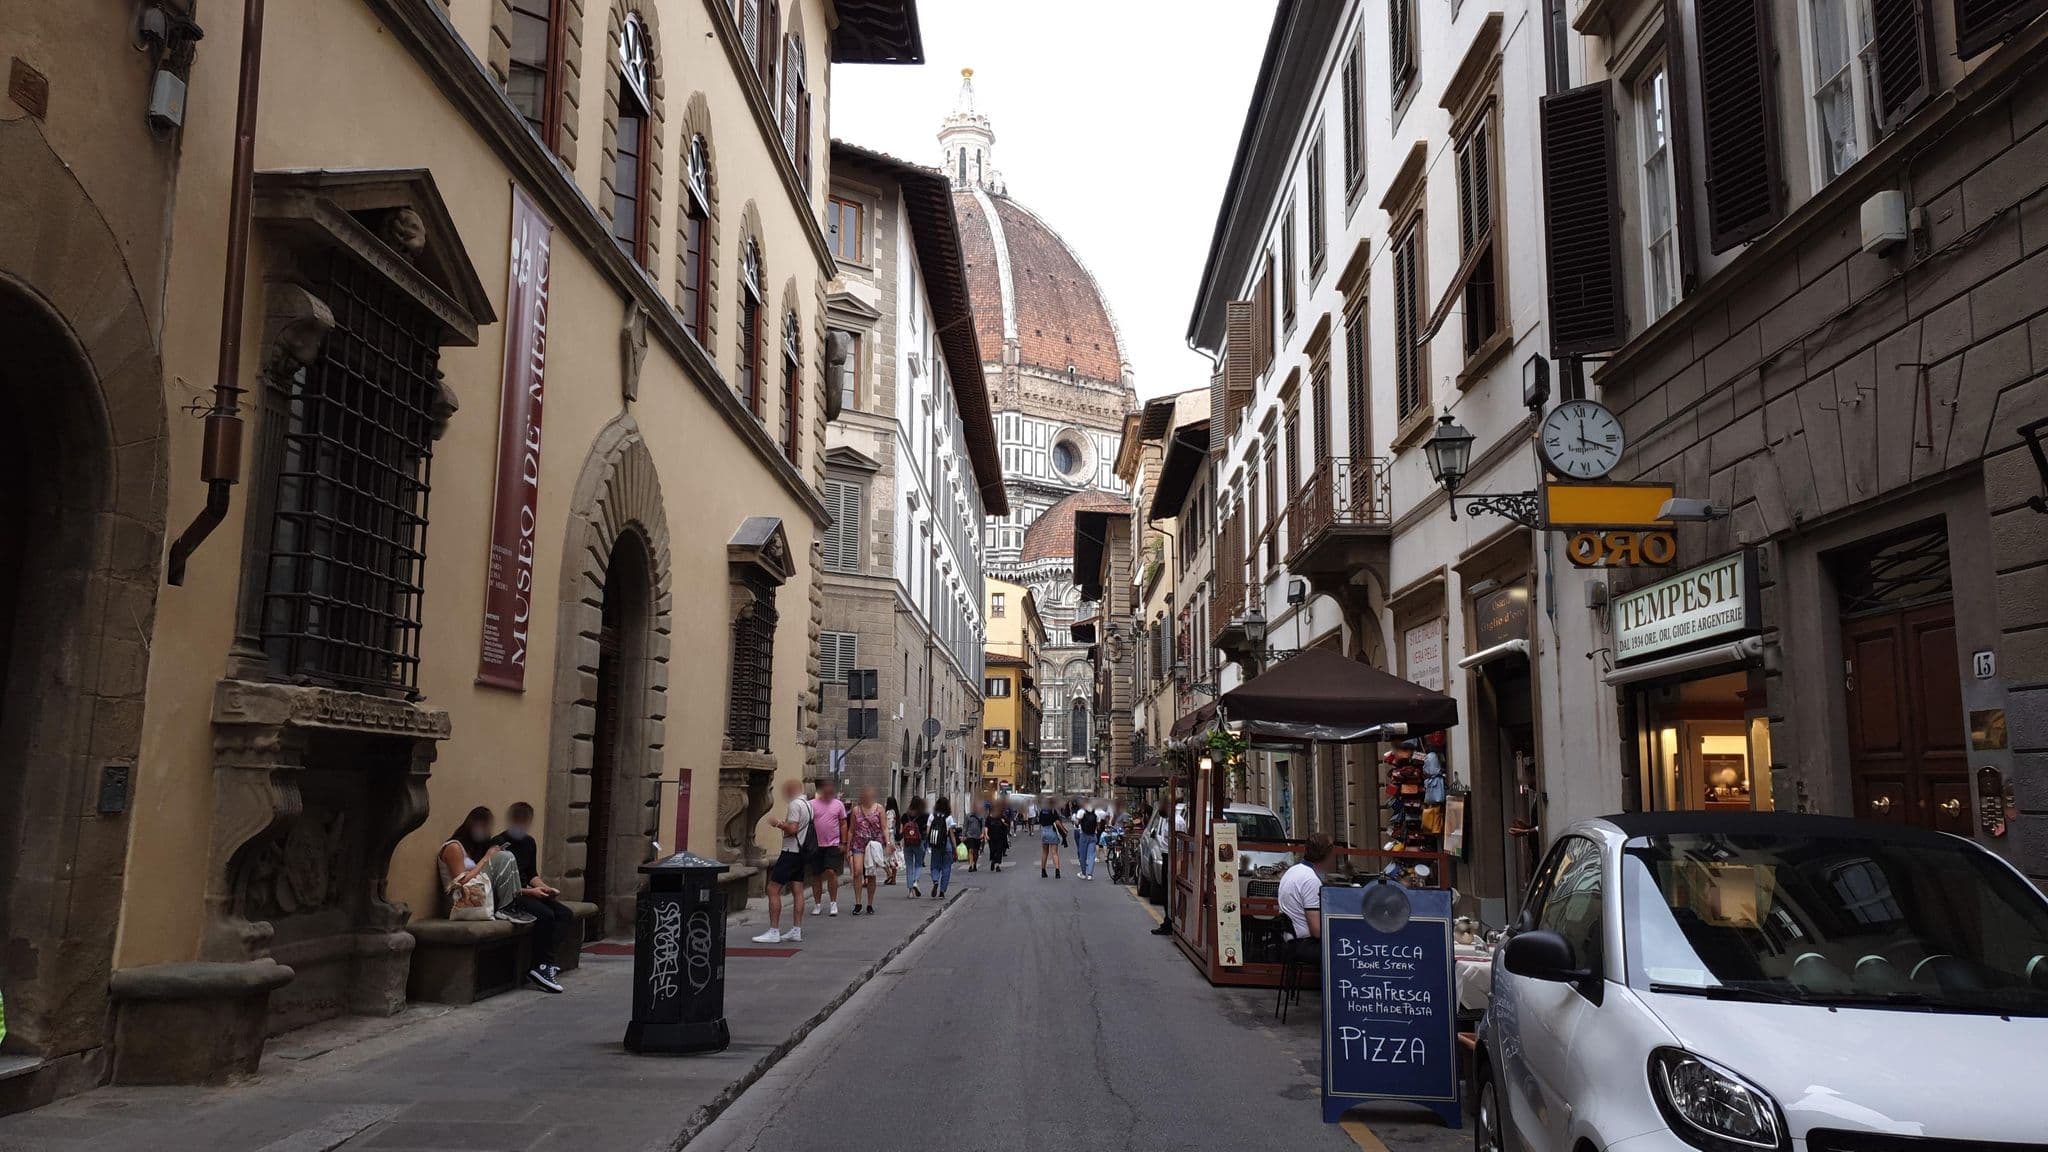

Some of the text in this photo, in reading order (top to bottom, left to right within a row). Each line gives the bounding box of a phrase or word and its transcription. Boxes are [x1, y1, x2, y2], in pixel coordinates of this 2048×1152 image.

[511, 504, 536, 667] MUSEO
[529, 236, 550, 408] MEDICI
[1620, 561, 1739, 632] TEMPESTI
[1619, 640, 1631, 653] DAL
[1632, 635, 1644, 649] 1934
[1672, 622, 1691, 639] GIOIE
[1697, 607, 1743, 632] ARGENTERIE
[1383, 959, 1416, 971] STEAK
